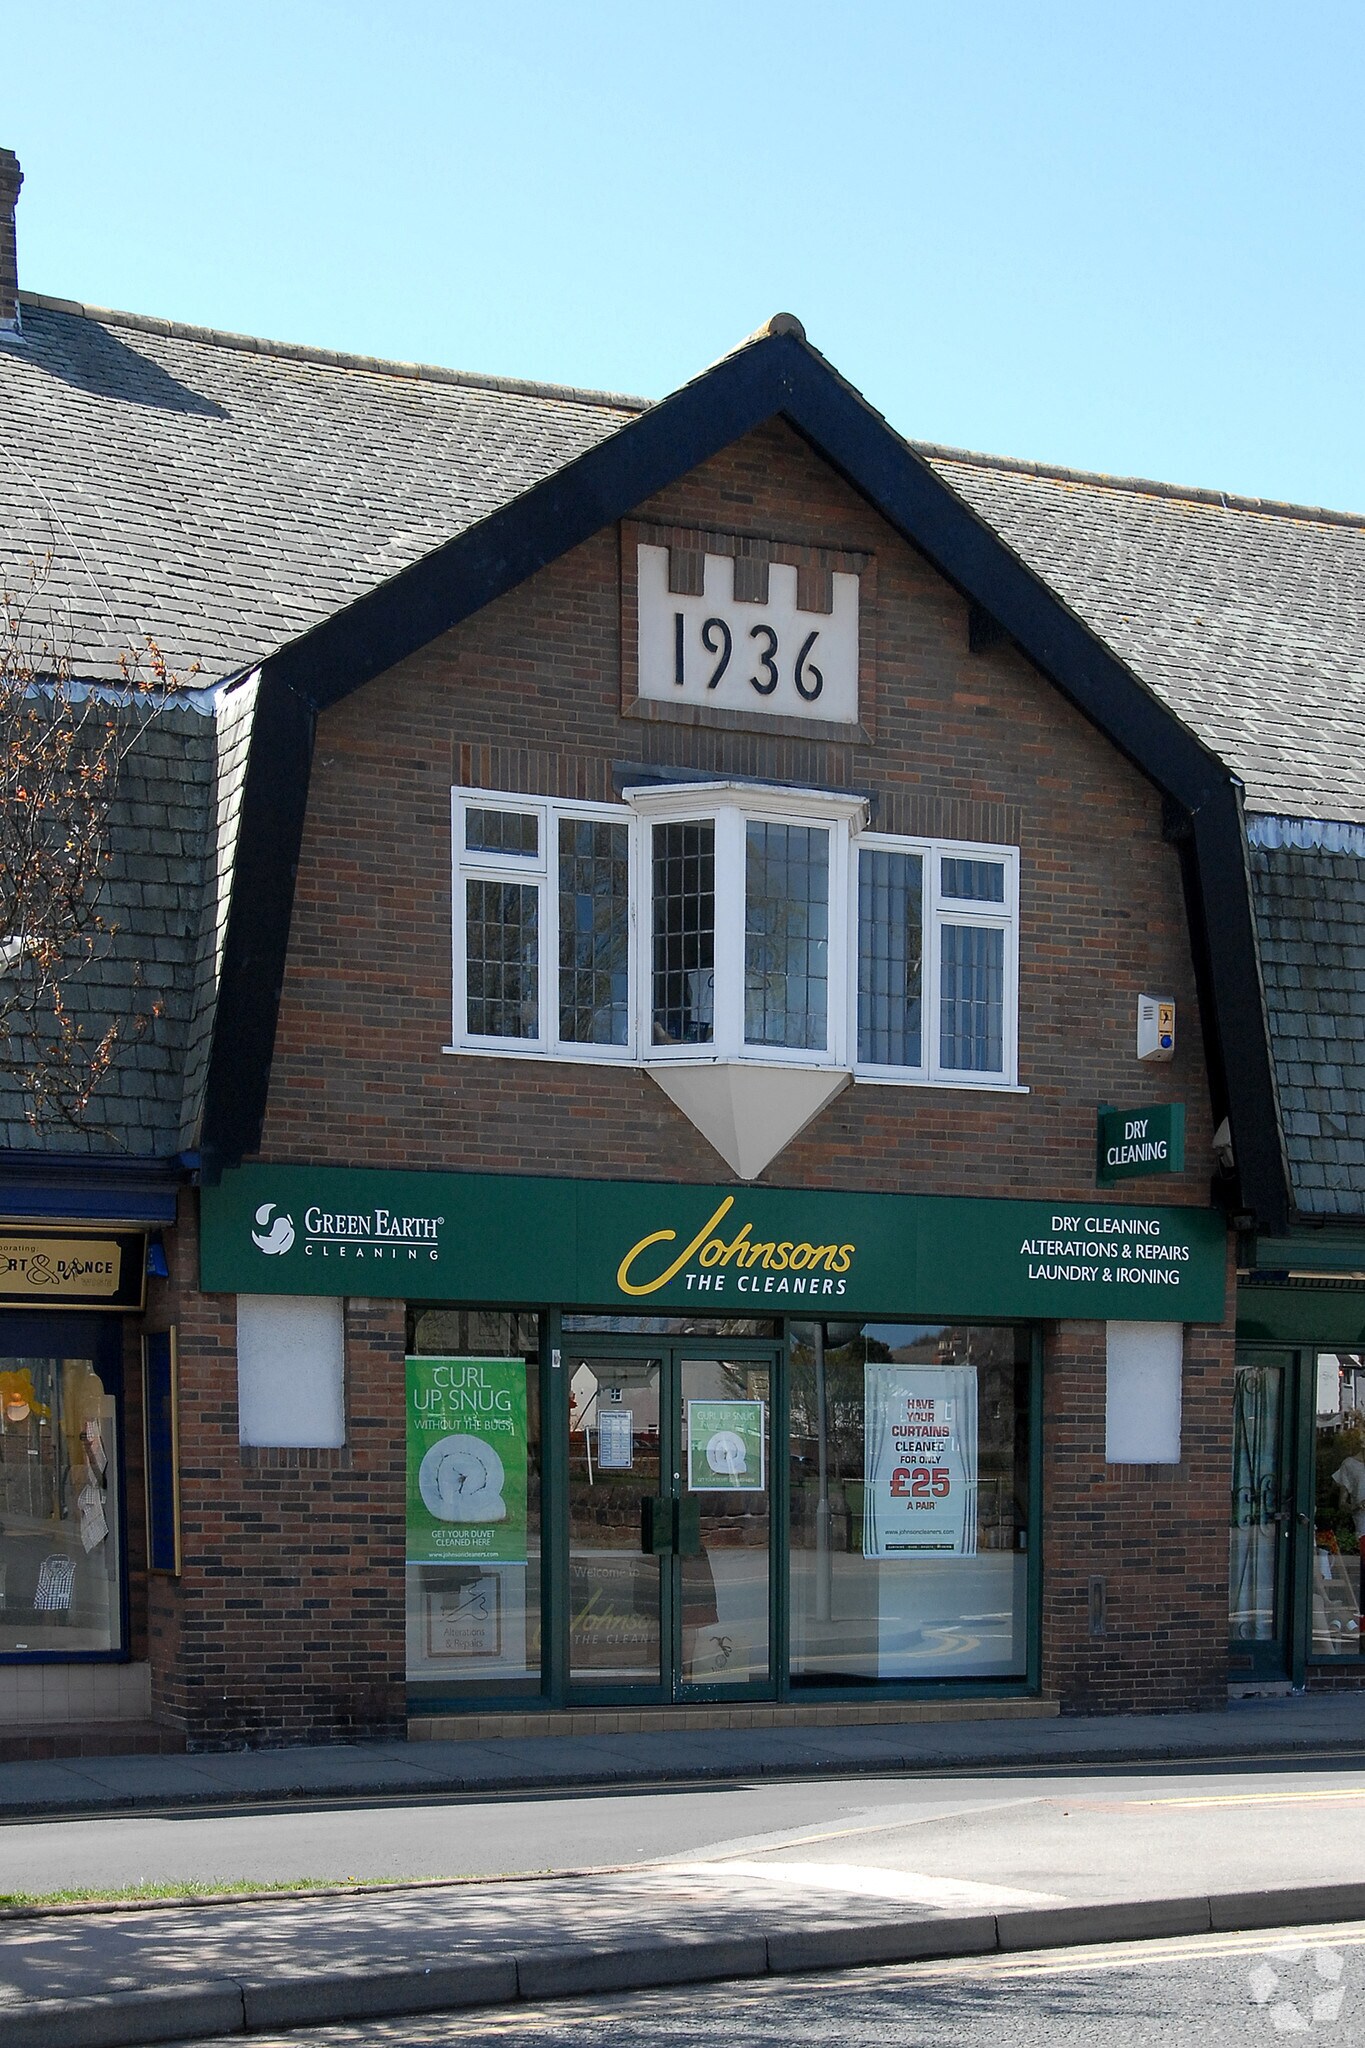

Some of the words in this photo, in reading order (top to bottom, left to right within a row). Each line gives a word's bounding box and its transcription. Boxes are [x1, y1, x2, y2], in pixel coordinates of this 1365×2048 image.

[674, 612, 824, 702] 1936
[1125, 1119, 1149, 1140] DRY
[1107, 1140, 1167, 1166] CLEANING
[1051, 1216, 1081, 1232] DRY
[1084, 1217, 1160, 1236] CLEANING
[616, 1195, 856, 1296] Johnsons
[1020, 1240, 1118, 1258] ALTERATIONS
[1121, 1244, 1132, 1259] &
[1135, 1244, 1189, 1261] REPAIRS
[305, 1245, 439, 1261] CLEANING
[26, 1253, 60, 1285] &
[1028, 1264, 1099, 1282] LAUNDRY
[1101, 1267, 1113, 1282] &
[1116, 1267, 1180, 1285] IRONING
[685, 1274, 725, 1291] THE
[737, 1275, 847, 1295] CLEANERS
[433, 1366, 491, 1388] CURL
[414, 1389, 442, 1410] UP
[449, 1390, 511, 1411] SNUG
[907, 1399, 935, 1409] HAVE
[697, 1411, 715, 1420] CURL
[732, 1411, 755, 1420] SNUG
[906, 1412, 935, 1422] YOUR
[414, 1420, 461, 1430] WITHOUT
[464, 1420, 482, 1430] THE
[892, 1425, 950, 1437] CURTAINS
[900, 1456, 917, 1464] FOR
[919, 1456, 941, 1464] ONLY
[890, 1467, 951, 1498] £25
[907, 1502, 914, 1510] A
[431, 1530, 448, 1538] GET
[448, 1530, 470, 1538] YOUR
[471, 1530, 495, 1538] DUVET
[885, 1528, 955, 1536] www.johnsoncleaners.com
[436, 1539, 471, 1547] CLEANED
[472, 1538, 491, 1546] HERE
[574, 1566, 624, 1578] Welcome
[443, 1628, 486, 1637] Alterations
[454, 1639, 484, 1649] Repairs
[574, 1634, 599, 1645] THE
